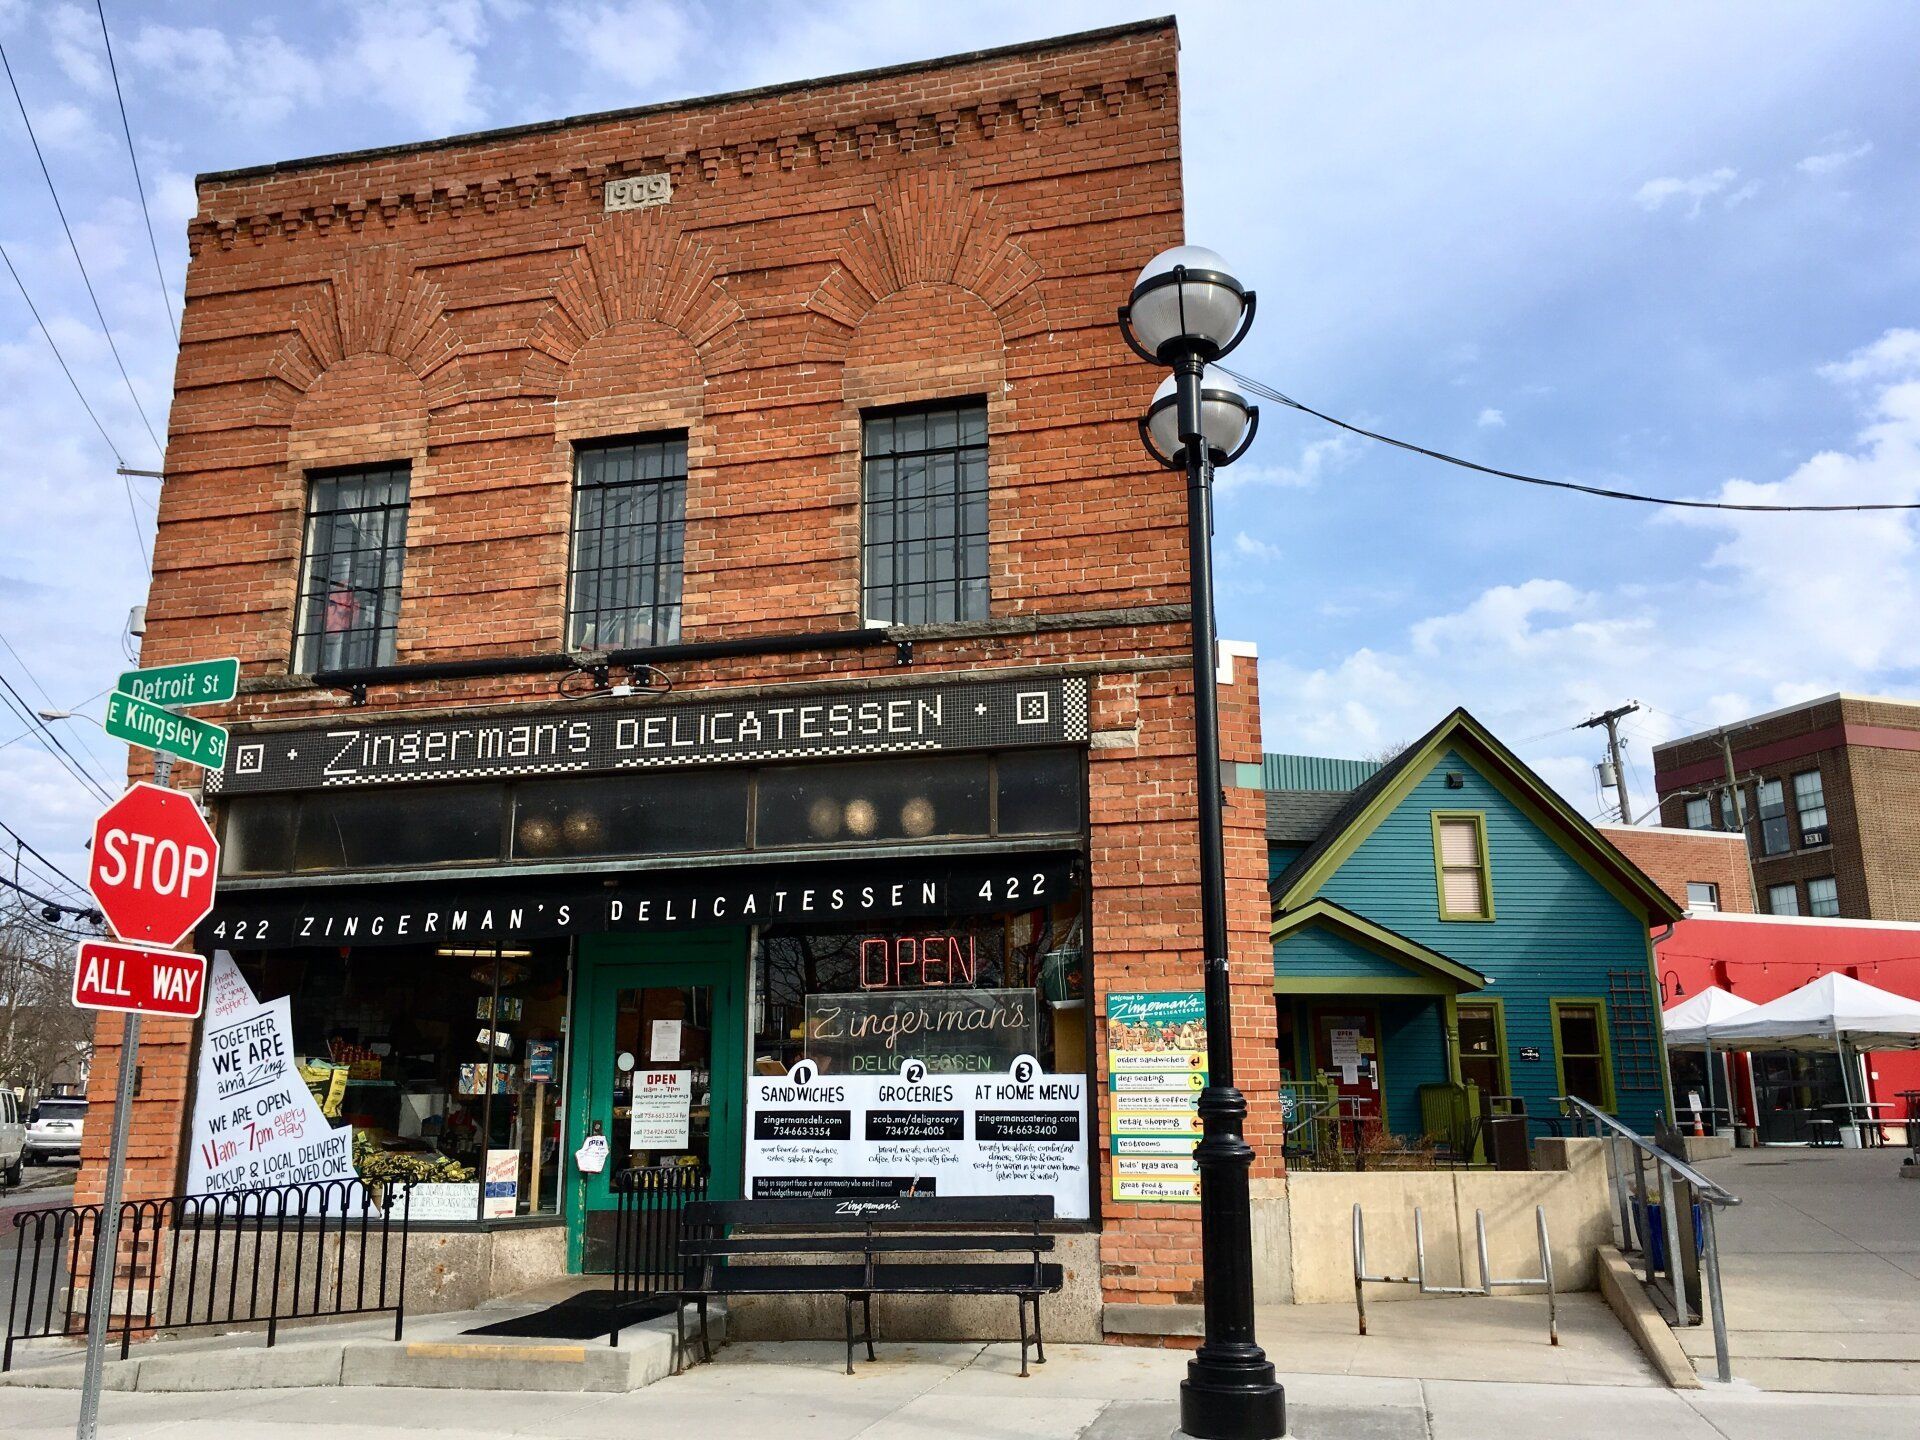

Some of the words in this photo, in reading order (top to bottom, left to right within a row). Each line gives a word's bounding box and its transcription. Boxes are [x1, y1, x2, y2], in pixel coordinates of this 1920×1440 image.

[132, 673, 195, 700] Detroit
[202, 674, 219, 694] St
[108, 702, 120, 722] E
[125, 702, 203, 755] Kingsley
[208, 736, 224, 758] St
[323, 720, 591, 775] Zingerman's
[616, 694, 942, 750] DELICATESSEN
[99, 828, 209, 898] STOP
[213, 920, 269, 940] 422
[299, 904, 570, 937] ZINGERMAN'S
[611, 882, 936, 922] DELICATESSEN
[978, 873, 1046, 900] 422
[861, 935, 975, 987] OPEN
[81, 957, 131, 996] ALL
[153, 965, 199, 1003] WAY
[214, 967, 238, 985] thank
[216, 980, 235, 993] you
[215, 991, 249, 1017] support
[1110, 994, 1201, 1020] Zingerman's
[211, 1018, 276, 1052] TOGETHER
[813, 1002, 1027, 1050] Zingerman's
[212, 1049, 241, 1075] WE
[249, 1033, 285, 1065] ARE
[852, 1054, 991, 1071] DELICTESSEN
[647, 1074, 677, 1085] OPEN
[761, 1086, 844, 1102] SANDWICHES
[879, 1085, 953, 1102] GROCERIES
[975, 1085, 991, 1100] AT
[996, 1084, 1034, 1100] HOME
[1039, 1084, 1080, 1100] MENU
[208, 1114, 227, 1135] WE
[232, 1105, 252, 1127] ARE
[257, 1089, 292, 1116] OPEN
[274, 1107, 307, 1128] every
[763, 1115, 842, 1126] zingermansdeli.com
[873, 1114, 959, 1125] zcob.me/deligrocery
[978, 1113, 1077, 1124] zingermanscatering.com
[1144, 1118, 1180, 1127] shopping
[278, 1121, 304, 1139] day
[205, 1165, 245, 1193] PICKUP
[249, 1161, 259, 1178] &
[263, 1151, 295, 1175] LOCAL
[299, 1134, 347, 1160] DELIVERY
[288, 1163, 320, 1185] LOVED
[322, 1155, 348, 1178] ONE
[1120, 1182, 1140, 1190] great
[835, 1200, 901, 1216] Zingerman's
